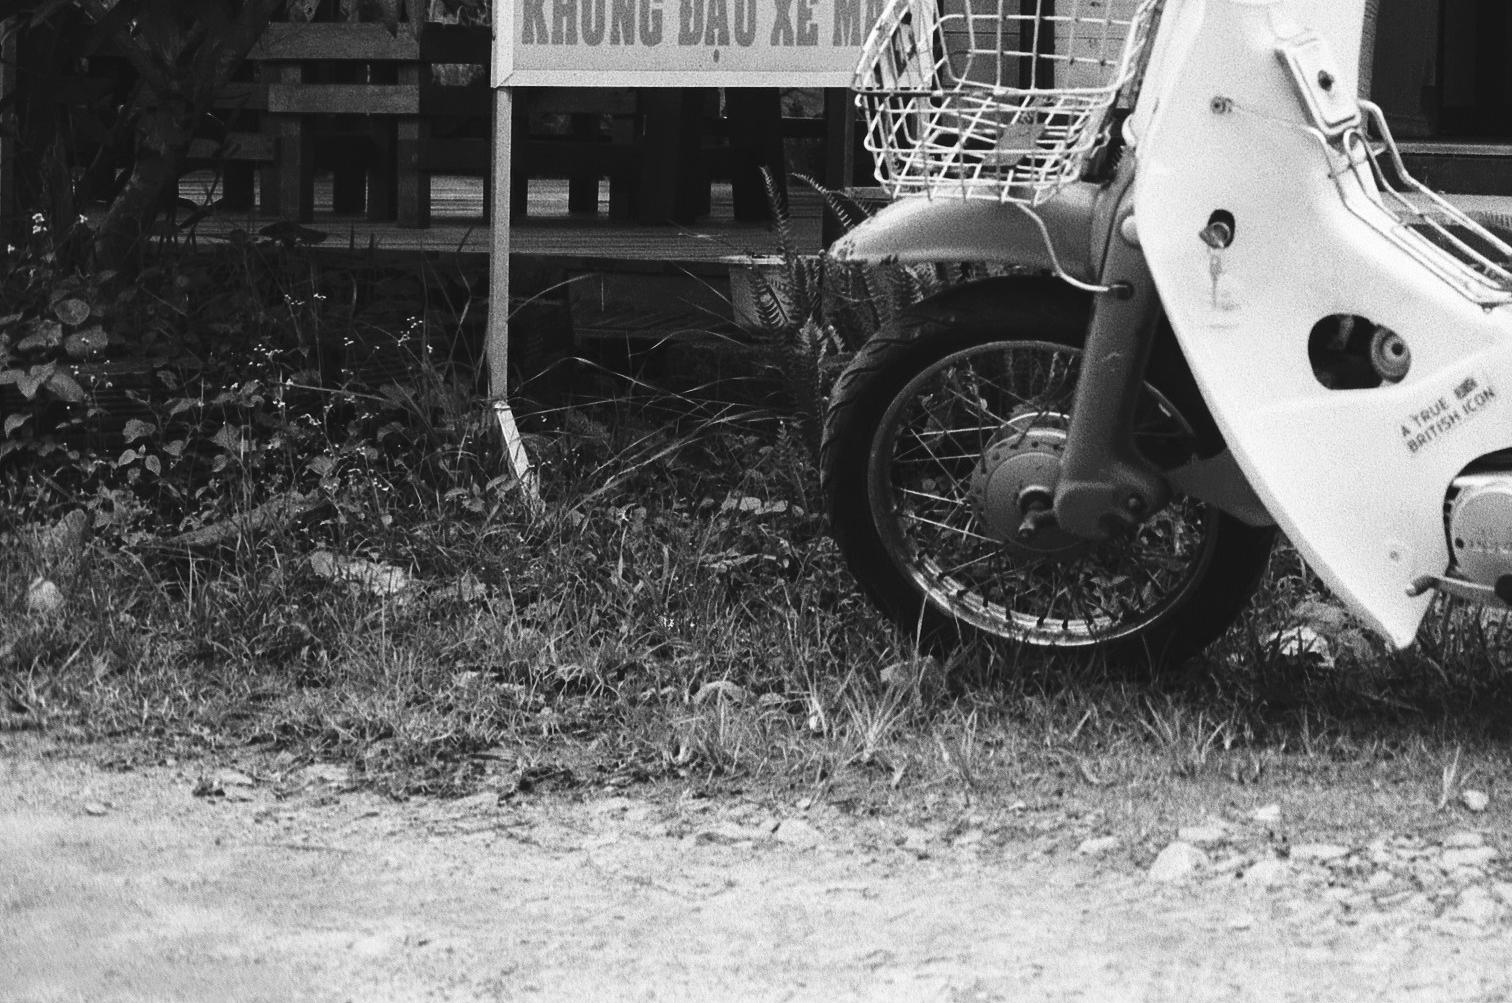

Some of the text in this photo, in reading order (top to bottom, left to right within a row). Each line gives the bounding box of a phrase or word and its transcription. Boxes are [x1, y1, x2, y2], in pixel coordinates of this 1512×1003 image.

[1400, 396, 1449, 437] A TRUE
[1407, 386, 1496, 454] BRITISH ICON
